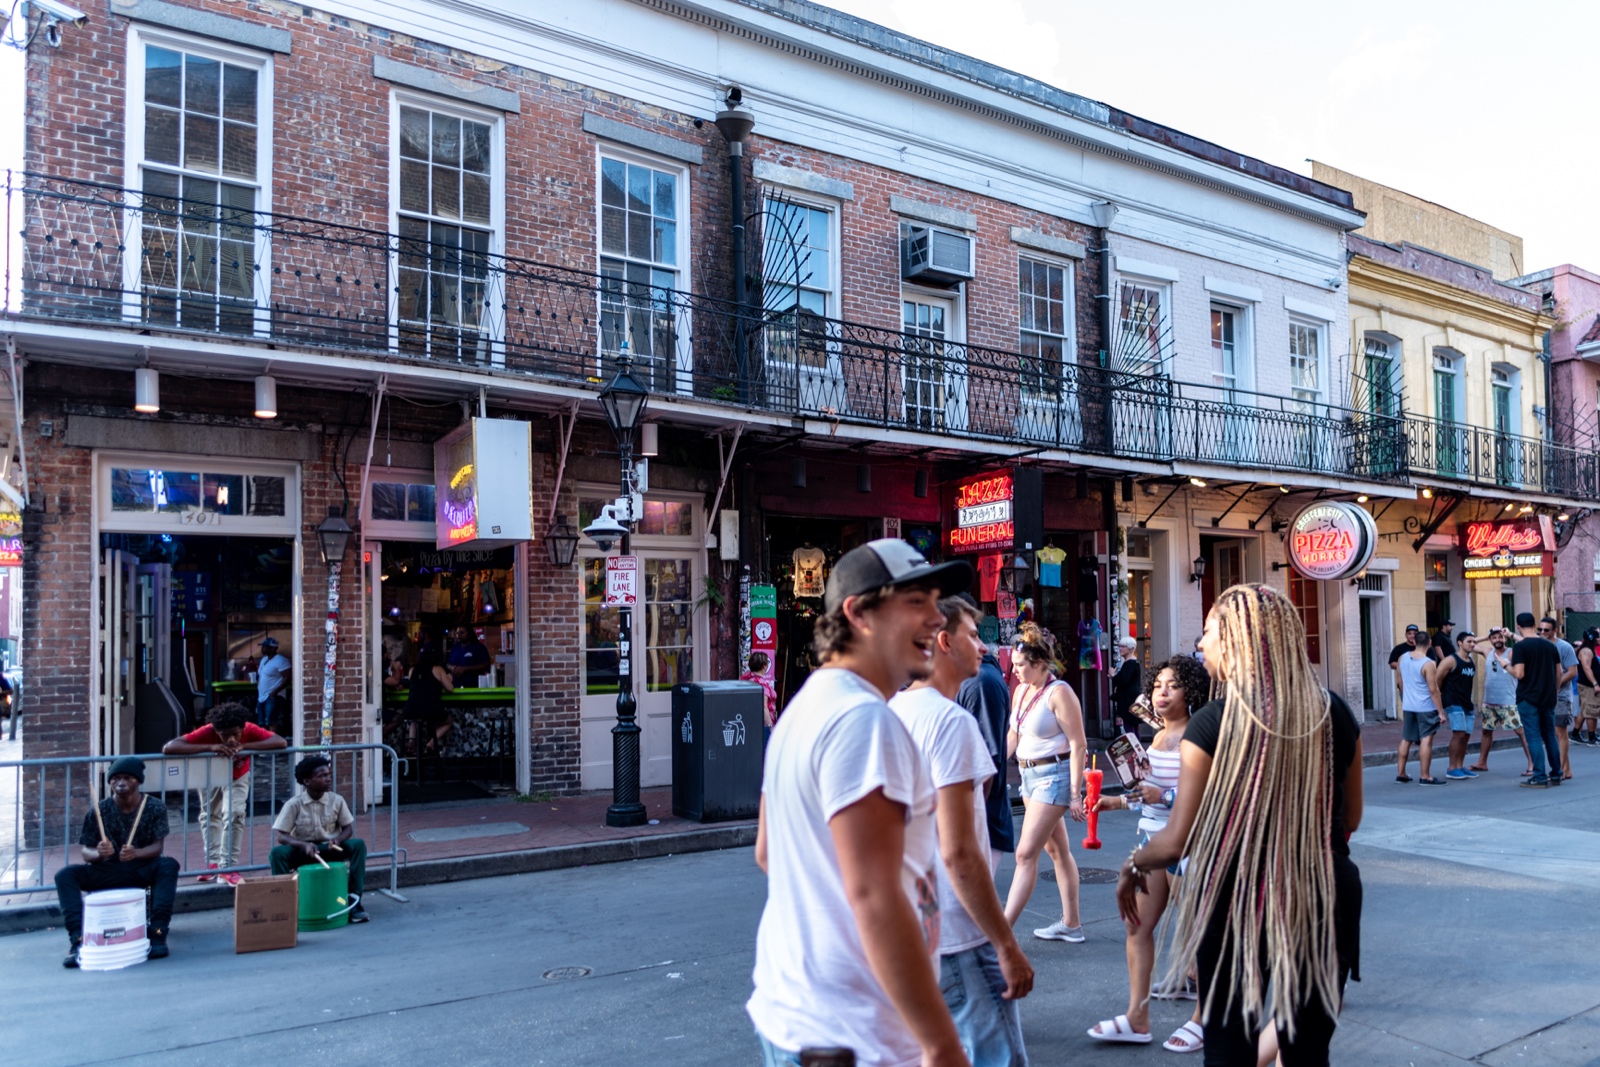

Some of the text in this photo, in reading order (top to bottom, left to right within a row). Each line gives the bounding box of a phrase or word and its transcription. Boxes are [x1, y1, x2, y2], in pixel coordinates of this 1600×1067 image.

[958, 477, 1006, 508] JAZZ
[186, 512, 215, 524] 401
[886, 518, 899, 528] 405
[1296, 507, 1344, 531] CRESCENT CITY
[950, 521, 1014, 545] FUNERAL
[1467, 523, 1541, 553] Willie's
[1295, 531, 1353, 553] PIZZA
[420, 551, 441, 567] Pizza
[1302, 551, 1347, 563] WORKS
[1464, 555, 1542, 568] CHICKEN SHACK
[608, 558, 618, 569] NO
[614, 572, 630, 581] FIRE
[1465, 570, 1497, 578] DAIQUIRIS
[1523, 567, 1543, 575] BEER
[612, 582, 631, 592] LANE
